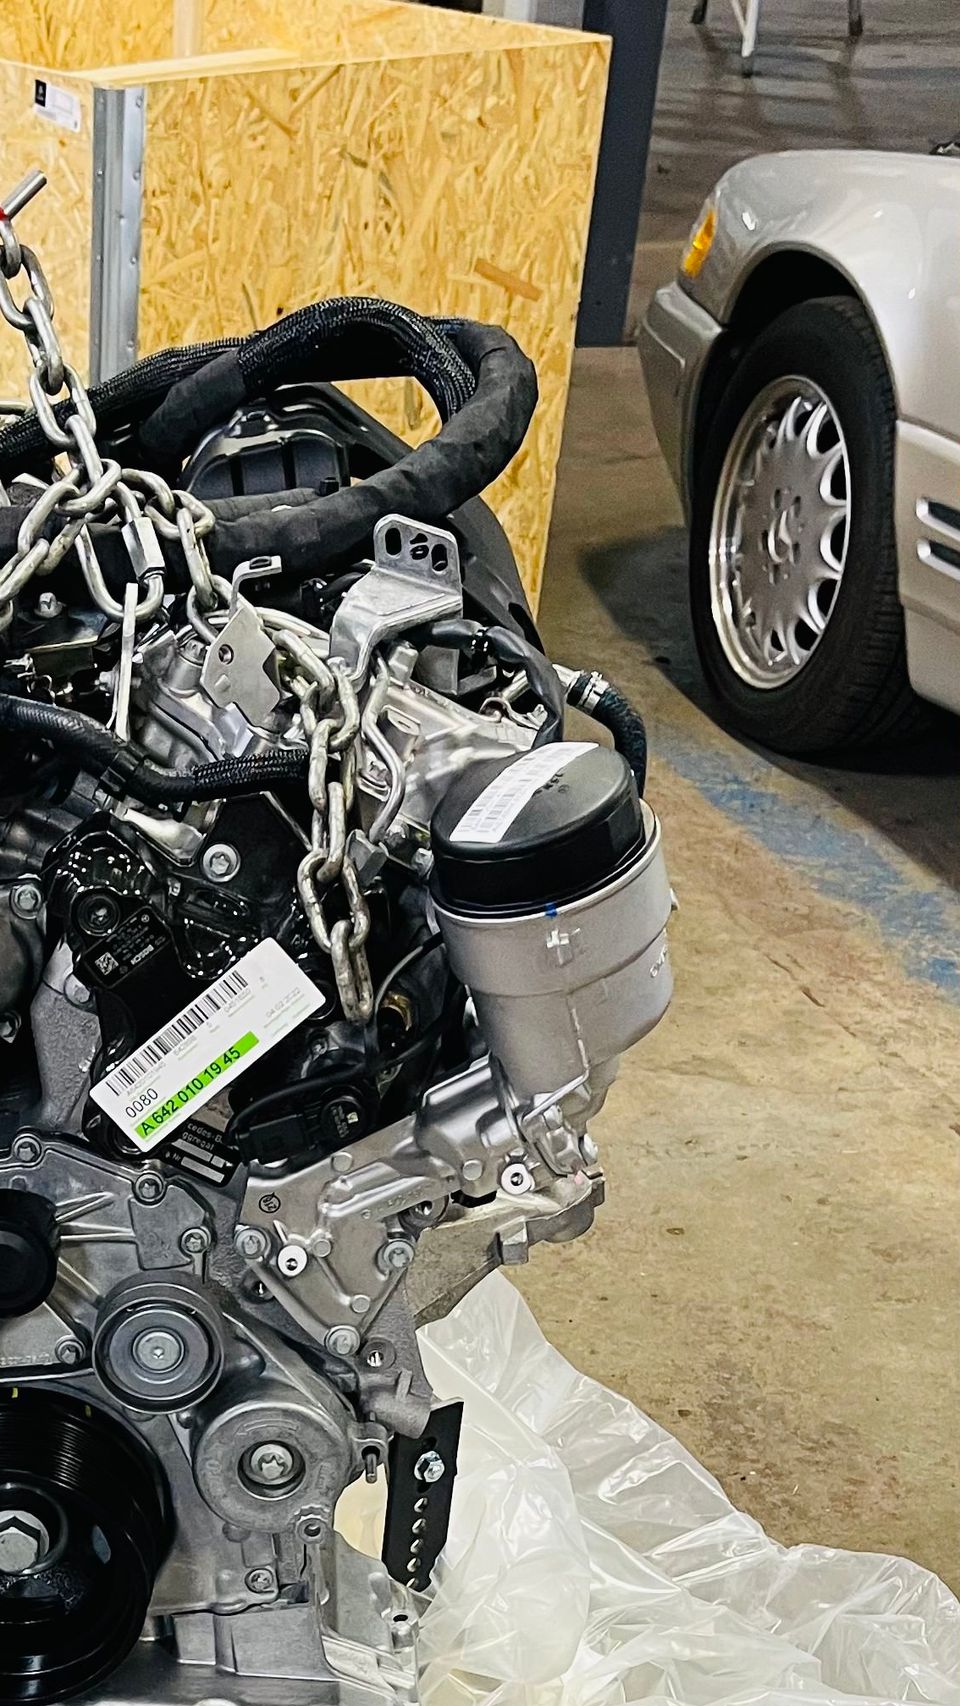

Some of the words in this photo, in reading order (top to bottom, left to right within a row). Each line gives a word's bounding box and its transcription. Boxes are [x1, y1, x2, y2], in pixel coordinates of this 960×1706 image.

[124, 1087, 159, 1119] 0080
[139, 1119, 156, 1136] A
[151, 1098, 179, 1125] 642
[176, 1077, 204, 1104] 010
[203, 1060, 223, 1082] 19
[220, 1045, 242, 1067] 45
